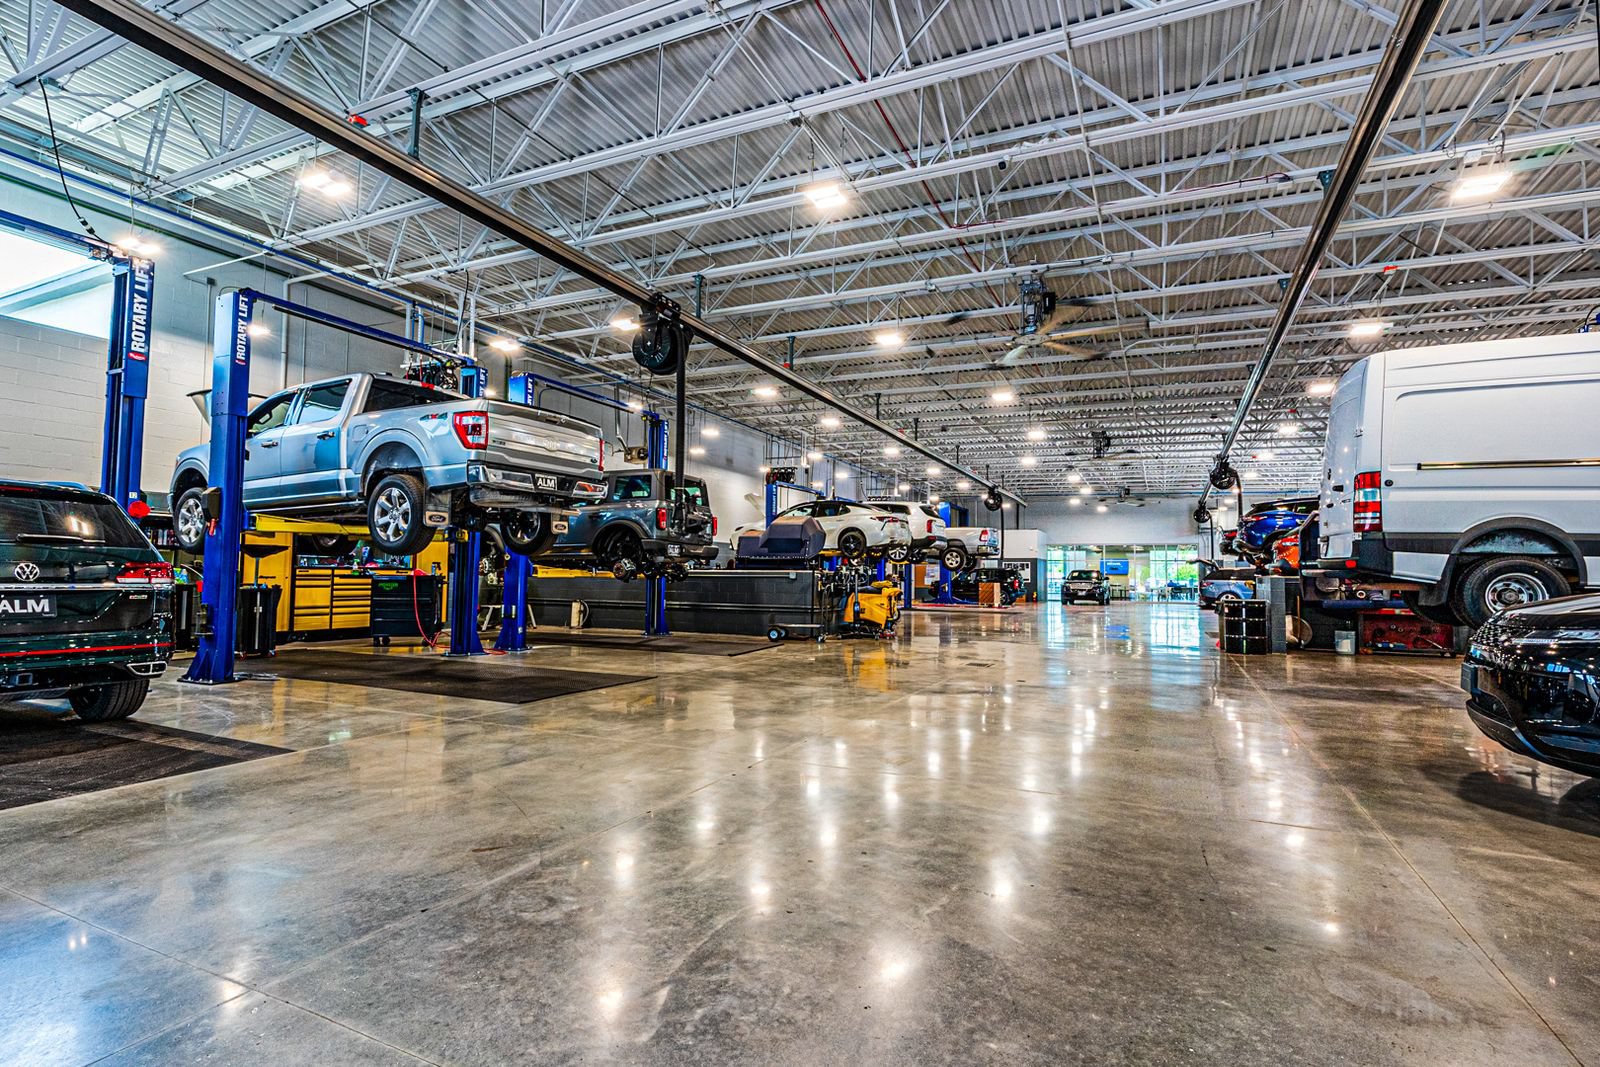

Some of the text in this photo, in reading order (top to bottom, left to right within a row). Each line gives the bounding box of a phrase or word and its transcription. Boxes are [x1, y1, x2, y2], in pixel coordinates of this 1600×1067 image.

[131, 259, 150, 353] ROTARY LIFT
[236, 294, 249, 360] ROTARY LIFT
[537, 478, 555, 488] ALM
[0, 599, 49, 613] ALM
